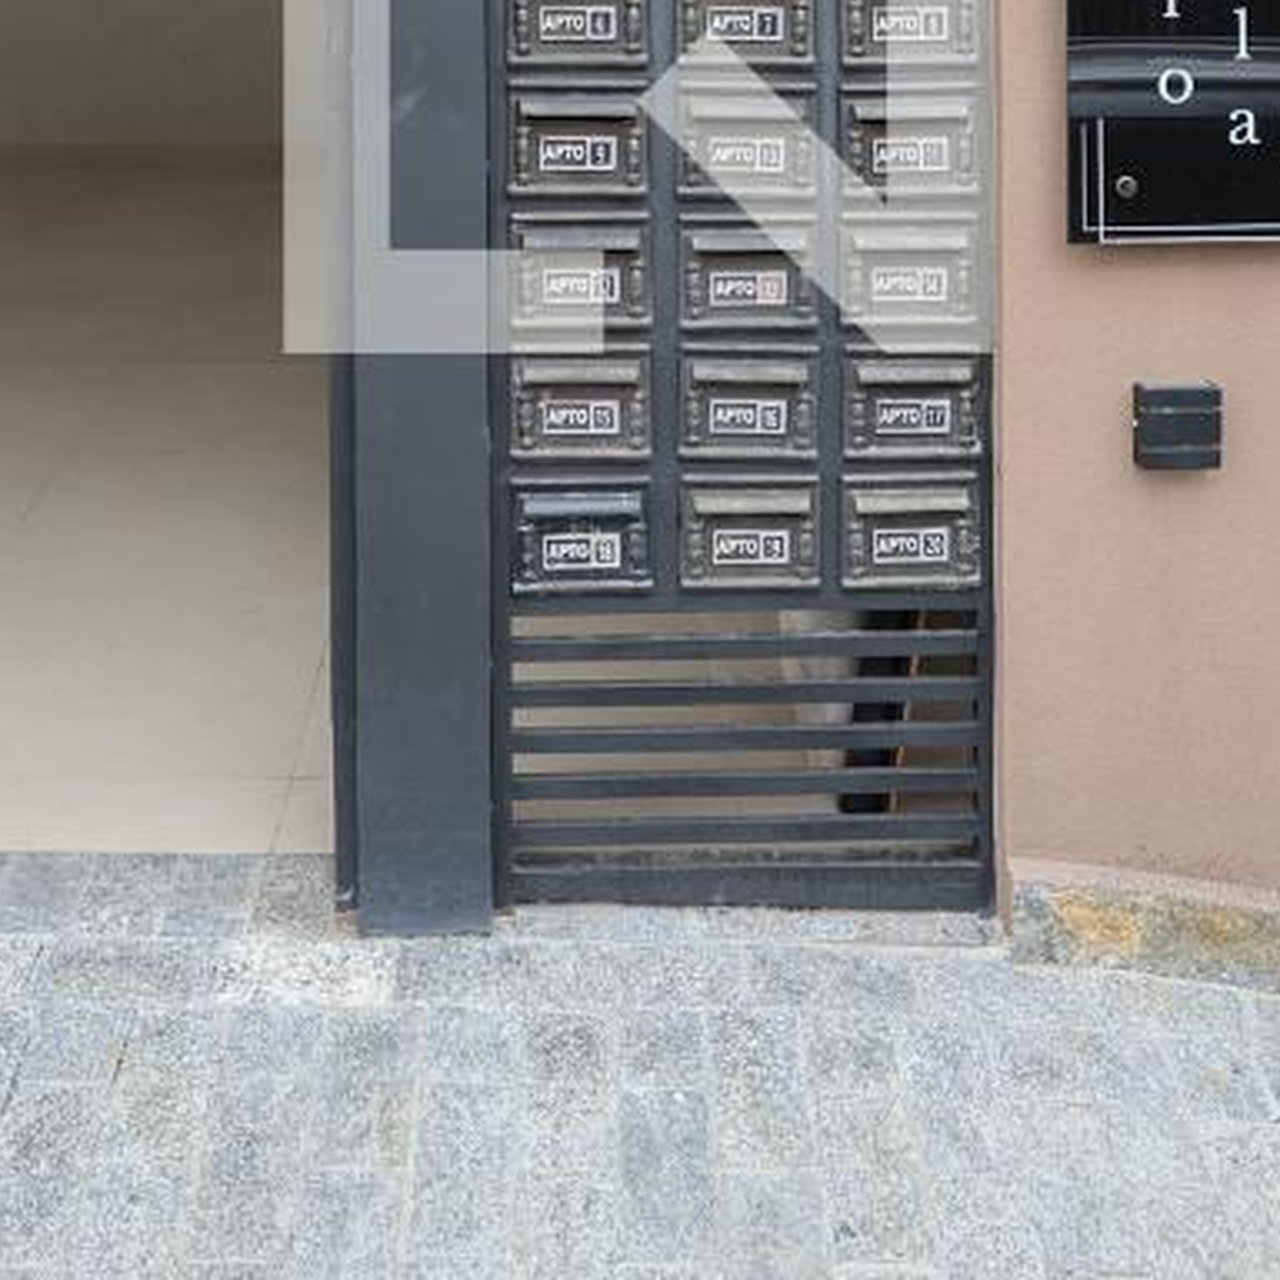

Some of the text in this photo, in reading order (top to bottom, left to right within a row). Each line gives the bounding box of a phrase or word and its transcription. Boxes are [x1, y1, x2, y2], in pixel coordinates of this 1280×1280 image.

[542, 14, 585, 31] APTO
[711, 14, 752, 31] APTO
[877, 14, 918, 31] APTO
[542, 144, 585, 162] APTO
[711, 145, 754, 162] APTO
[877, 145, 918, 162] APTO
[715, 278, 756, 297] APTO
[548, 407, 588, 425] APTO
[715, 407, 755, 425] APTO
[878, 407, 922, 425] APTO
[717, 537, 758, 555] APTO
[877, 536, 919, 553] APTO
